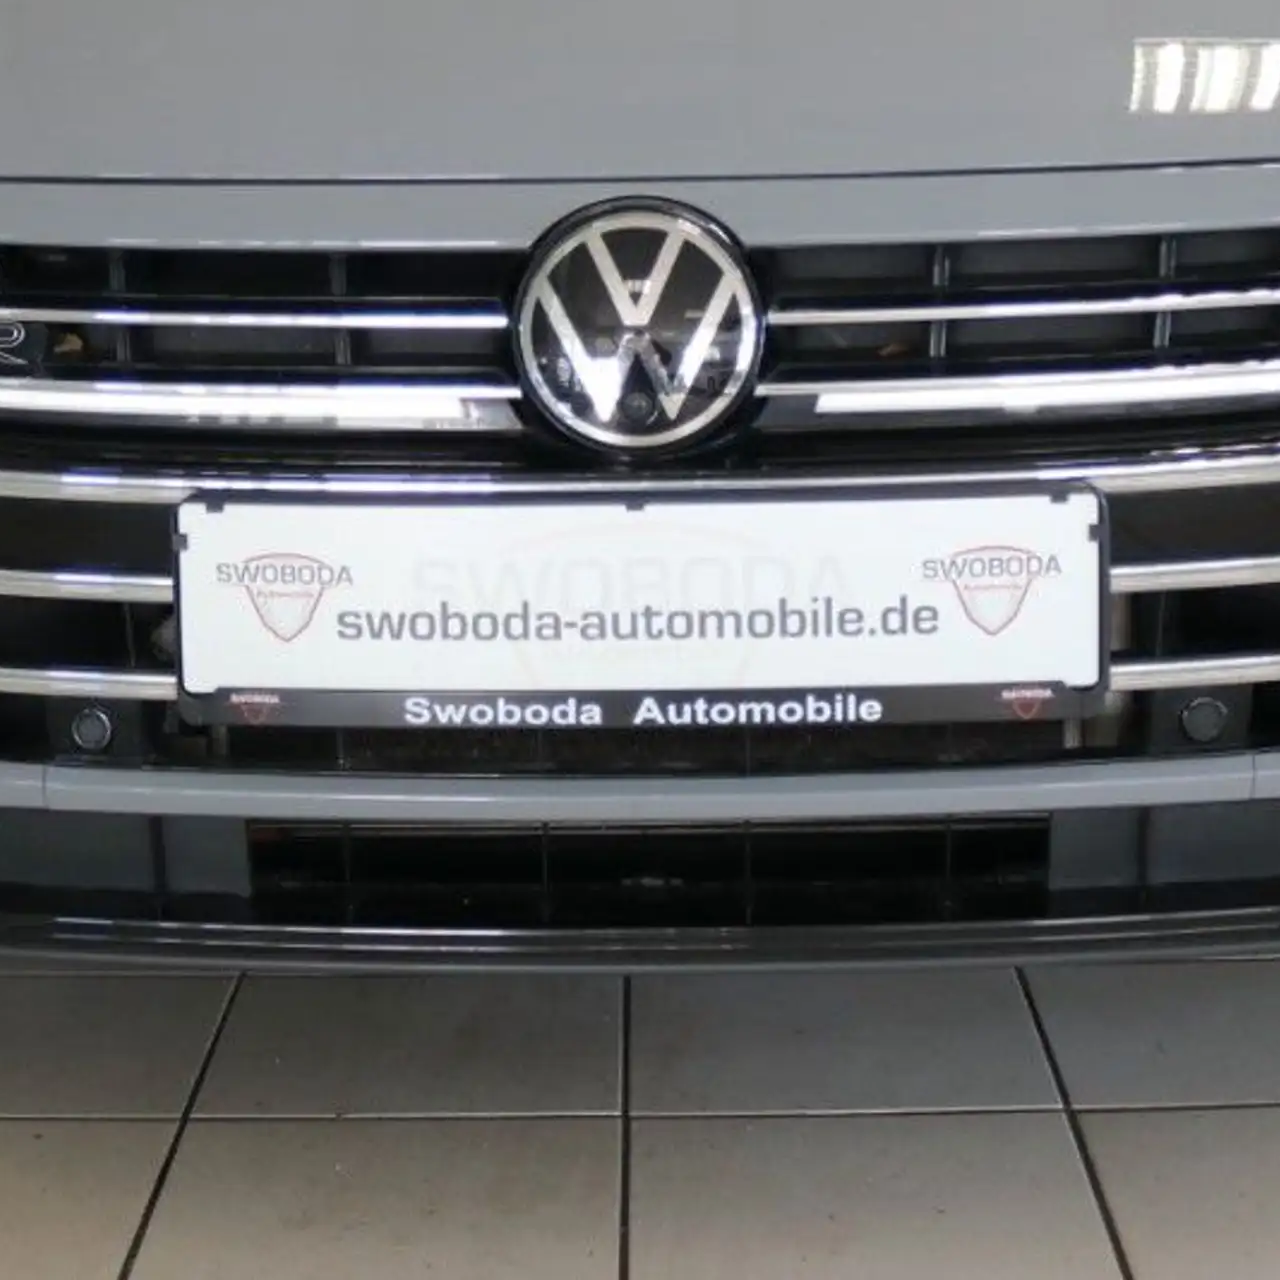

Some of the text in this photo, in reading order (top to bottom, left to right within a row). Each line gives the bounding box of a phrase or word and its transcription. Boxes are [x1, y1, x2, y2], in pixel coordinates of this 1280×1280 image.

[215, 561, 354, 587] SWOBODA
[922, 553, 1063, 580] SWOBODA
[337, 596, 939, 641] swoboda-automobile.de
[404, 695, 883, 726] Swoboda Automobile
